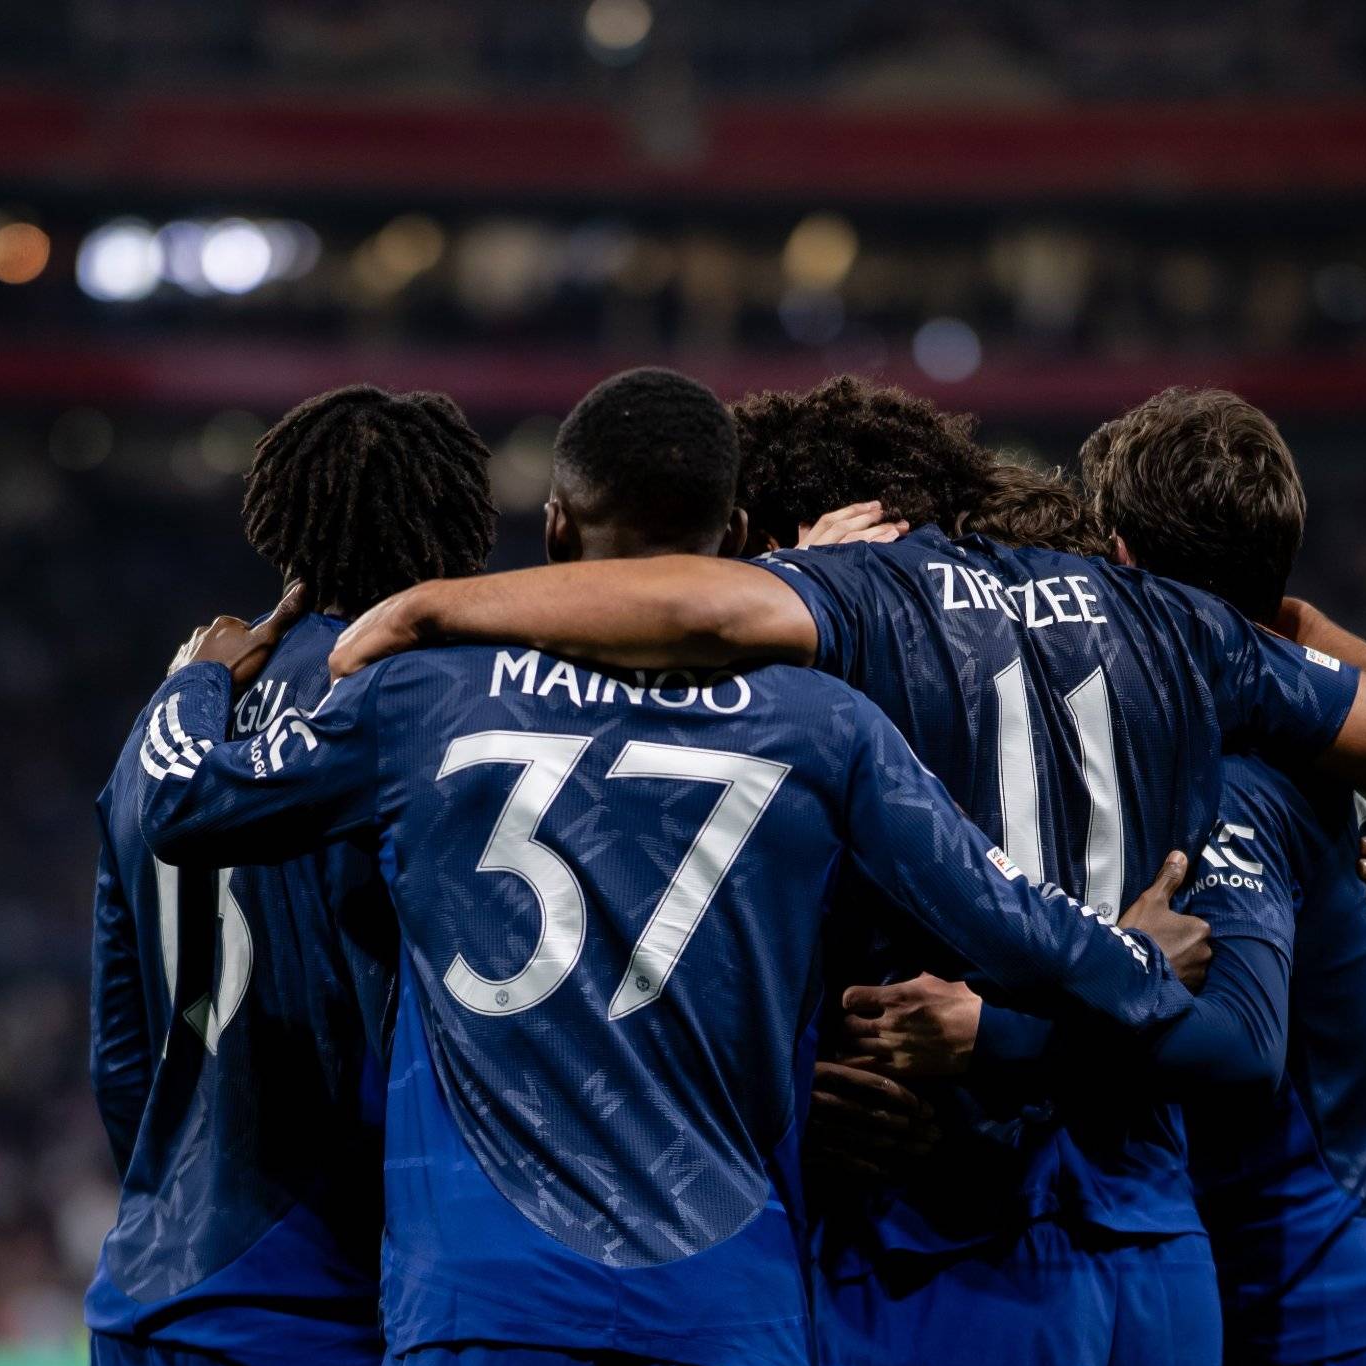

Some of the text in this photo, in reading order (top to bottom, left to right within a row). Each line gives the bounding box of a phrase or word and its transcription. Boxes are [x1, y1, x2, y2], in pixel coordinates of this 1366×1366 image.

[928, 562, 1108, 628] ZIRZEE
[489, 650, 751, 714] MAINOO
[993, 656, 1124, 925] 11
[435, 729, 793, 1021] 37
